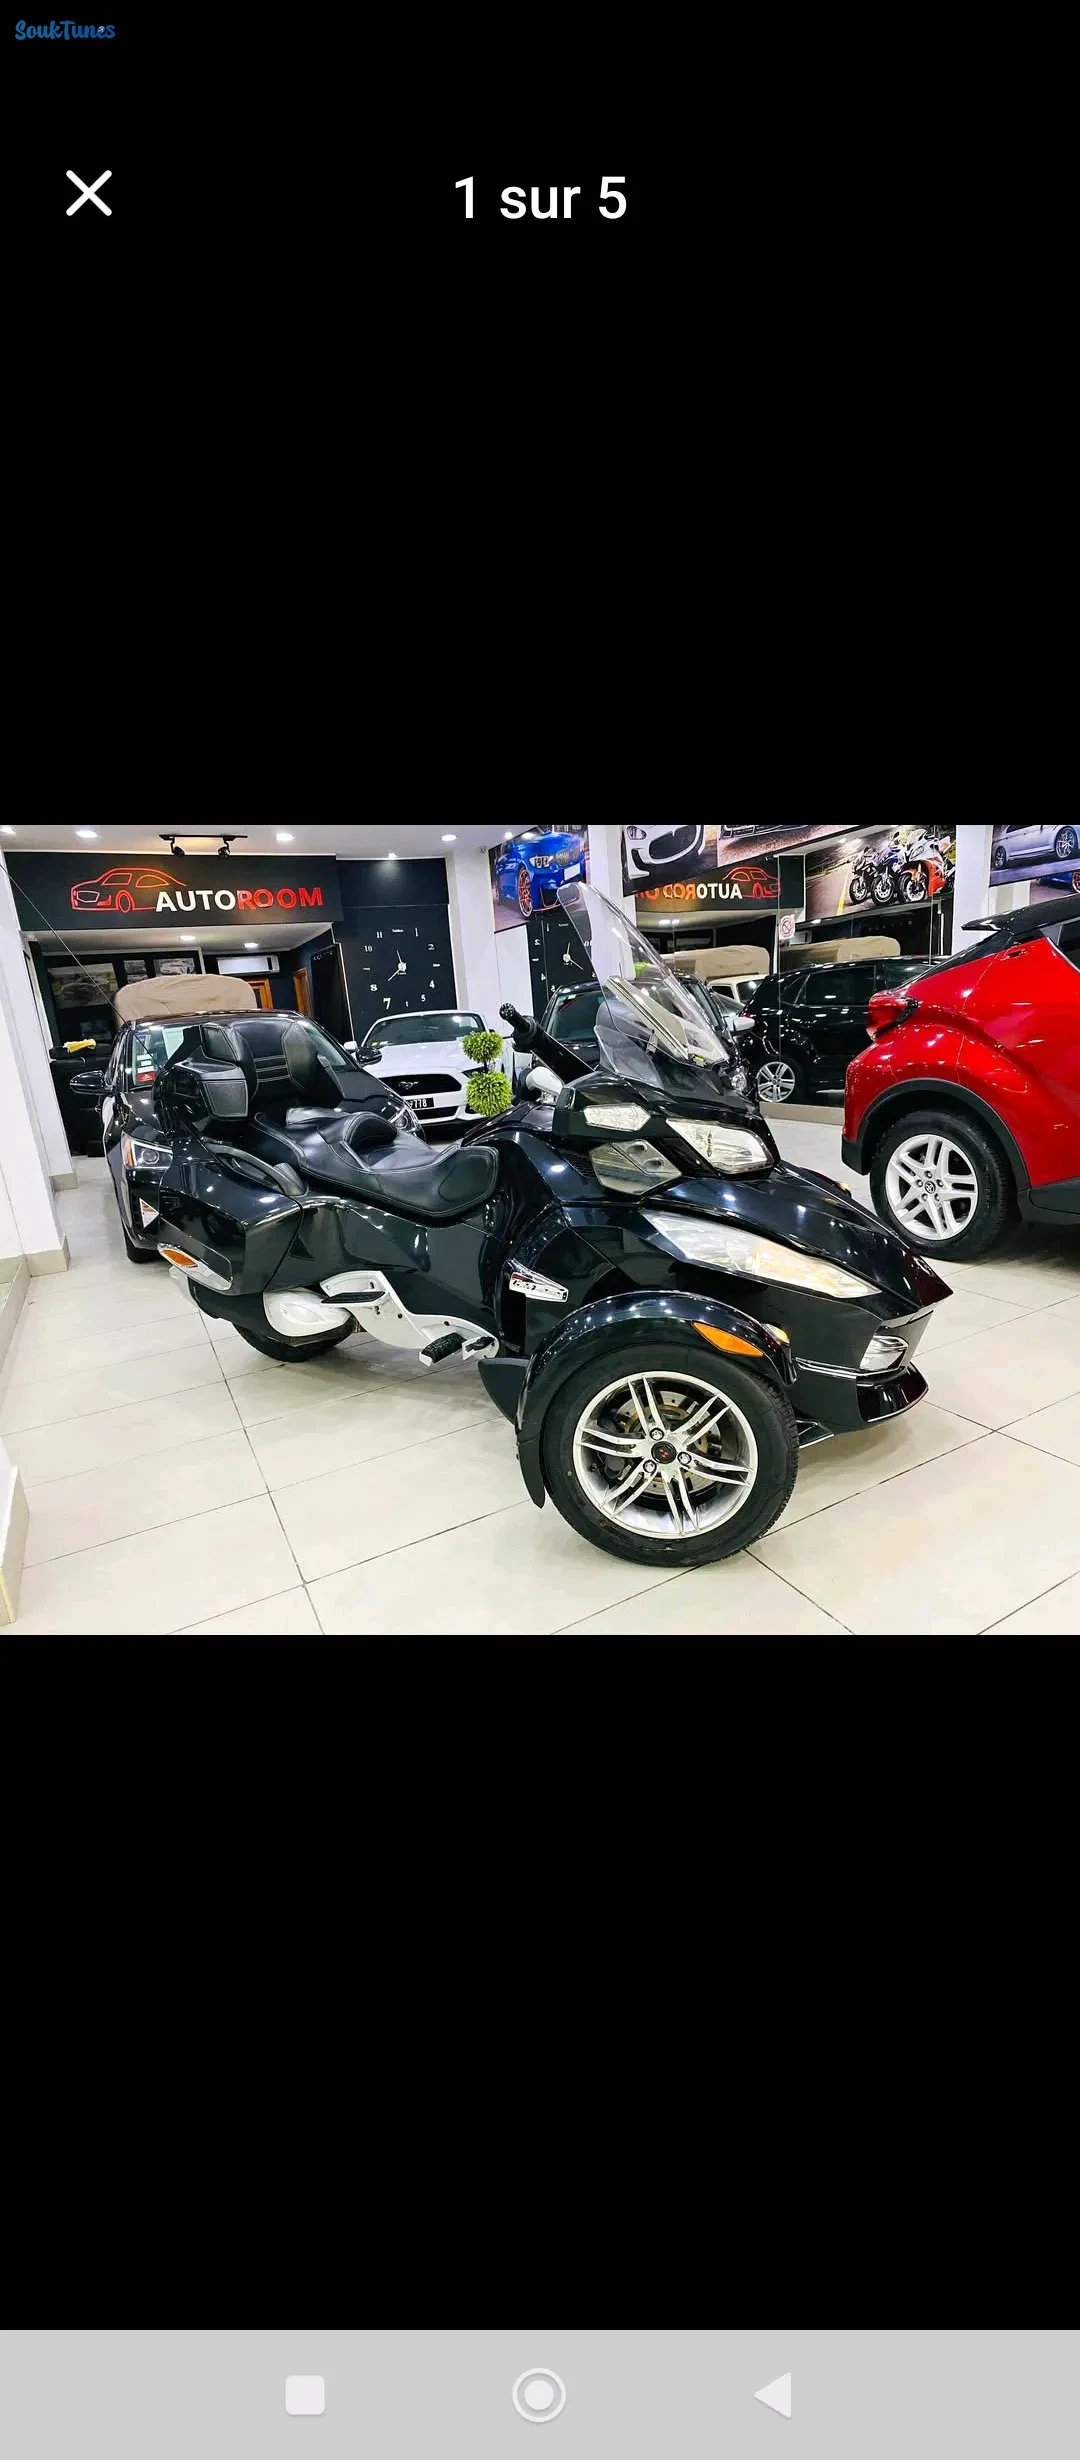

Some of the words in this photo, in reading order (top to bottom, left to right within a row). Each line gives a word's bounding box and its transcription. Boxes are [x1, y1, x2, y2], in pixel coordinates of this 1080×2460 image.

[156, 888, 322, 912] AUTOROOM
[429, 980, 435, 988] 4
[421, 994, 426, 1002] 5
[383, 998, 391, 1009] 7
